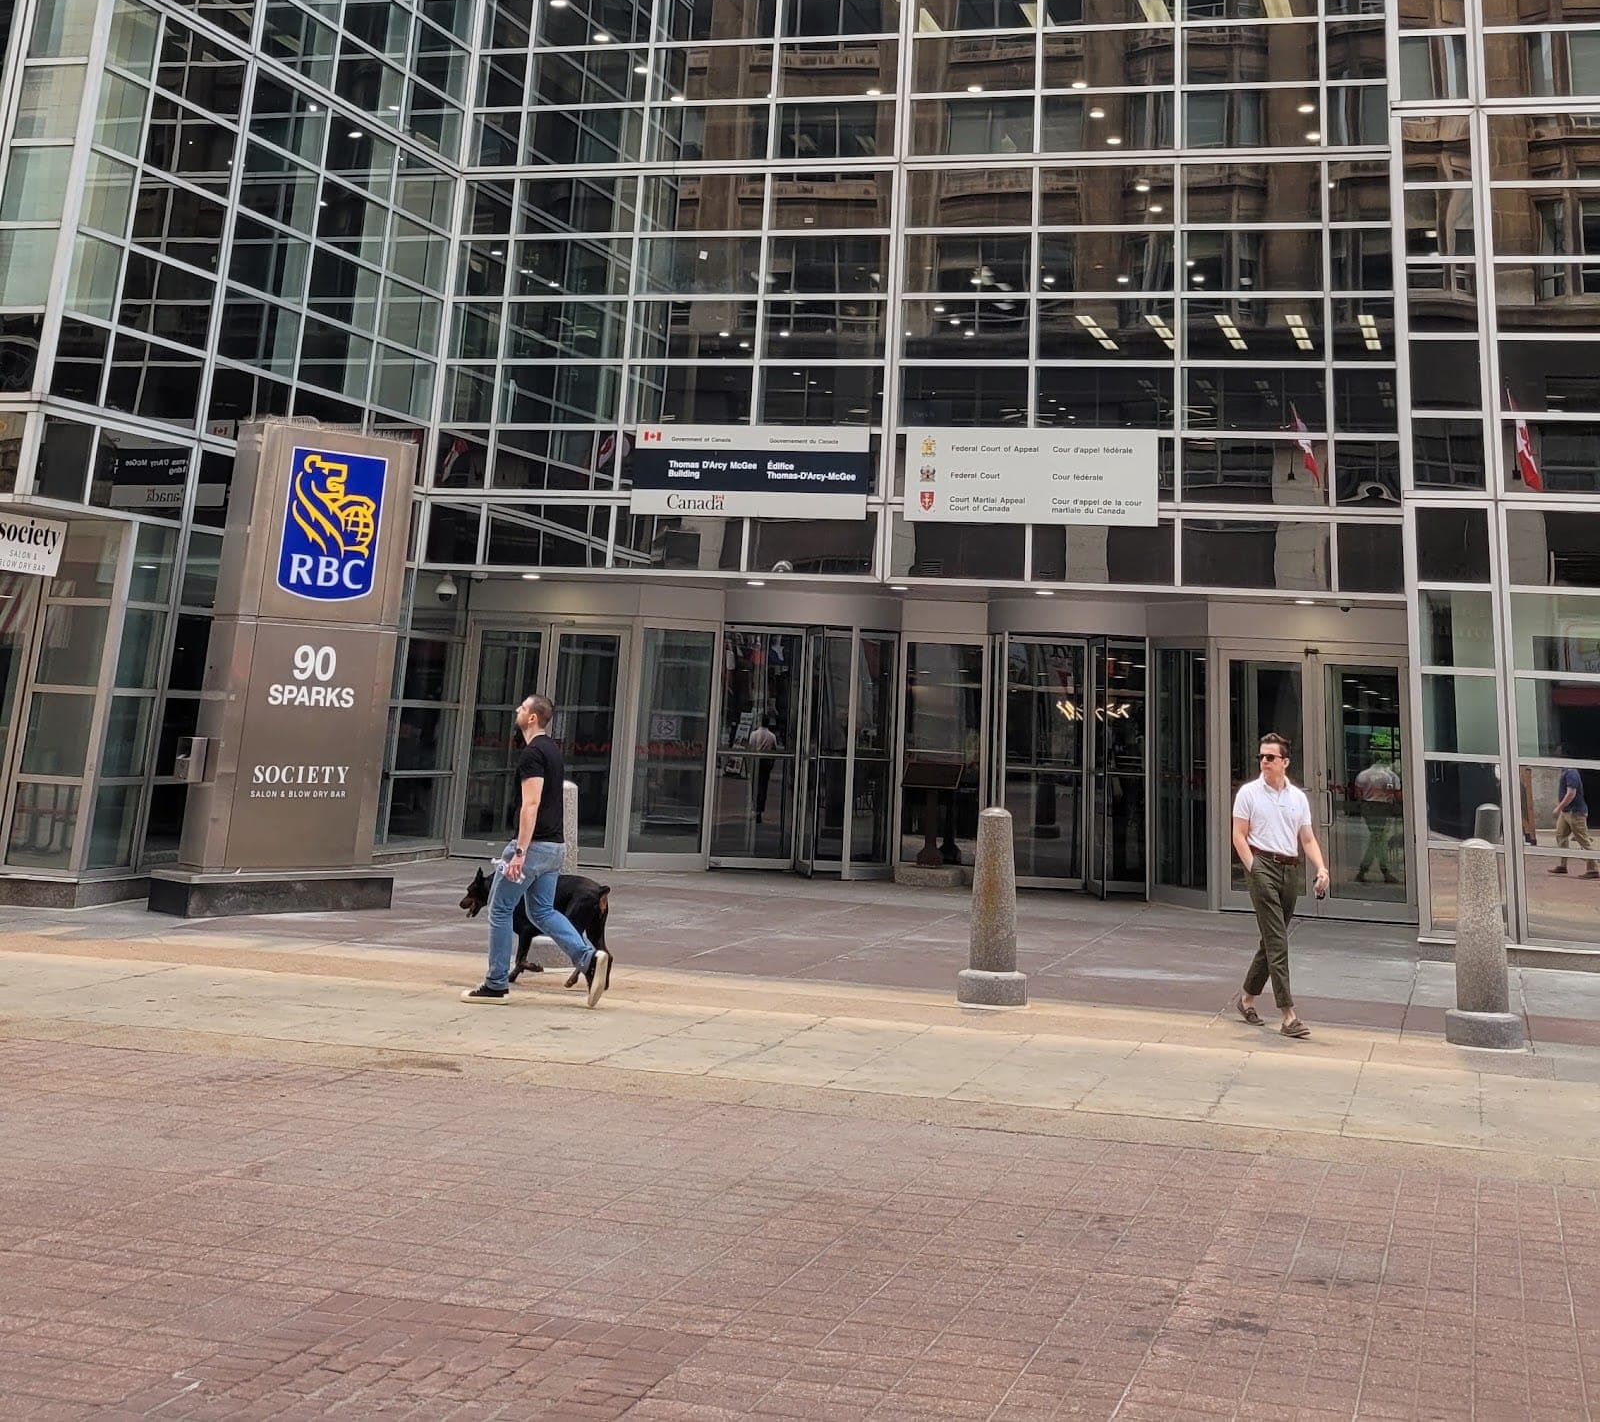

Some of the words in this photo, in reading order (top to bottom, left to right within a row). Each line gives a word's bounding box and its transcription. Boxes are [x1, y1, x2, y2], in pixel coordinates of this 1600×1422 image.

[951, 444, 978, 452] Federal
[980, 445, 1001, 453] Court
[1003, 445, 1011, 453] of
[1013, 445, 1039, 454] Appeal
[1073, 446, 1100, 455] d'appel
[1103, 446, 1133, 454] fédérale
[668, 459, 700, 469] Thomas
[702, 460, 727, 471] D'Arcy
[730, 461, 758, 470] McGee
[766, 459, 795, 471] Édifice
[668, 469, 700, 480] Building
[766, 470, 857, 482] Thomas-D'Arcy-McGee
[950, 471, 977, 479] Federal
[979, 472, 1001, 480] Court
[1073, 473, 1104, 481] fédérale
[666, 493, 725, 511] Canada
[949, 495, 970, 503] Court
[972, 496, 997, 504] Martial
[1000, 497, 1026, 505] Appeal
[1051, 497, 1070, 505] Cour
[1072, 498, 1100, 506] d'appel
[1102, 498, 1112, 506] de
[1115, 498, 1122, 507] la
[949, 504, 970, 512] Court
[972, 504, 980, 512] of
[982, 504, 1011, 512] Canada
[1051, 506, 1081, 514] martiale
[1084, 506, 1094, 514] du
[1096, 507, 1126, 515] Canada
[0, 519, 61, 555] society
[9, 549, 31, 559] SALON
[18, 560, 32, 570] DRY
[33, 563, 46, 572] BAR
[289, 552, 366, 590] RBC
[292, 644, 337, 682] 90
[267, 683, 355, 709] SPARKS
[252, 764, 350, 784] SOCIETY
[250, 789, 278, 798] SALON
[280, 790, 286, 798] &
[288, 790, 312, 798] BLOW
[313, 790, 329, 798] DRY
[330, 790, 346, 798] BAR
